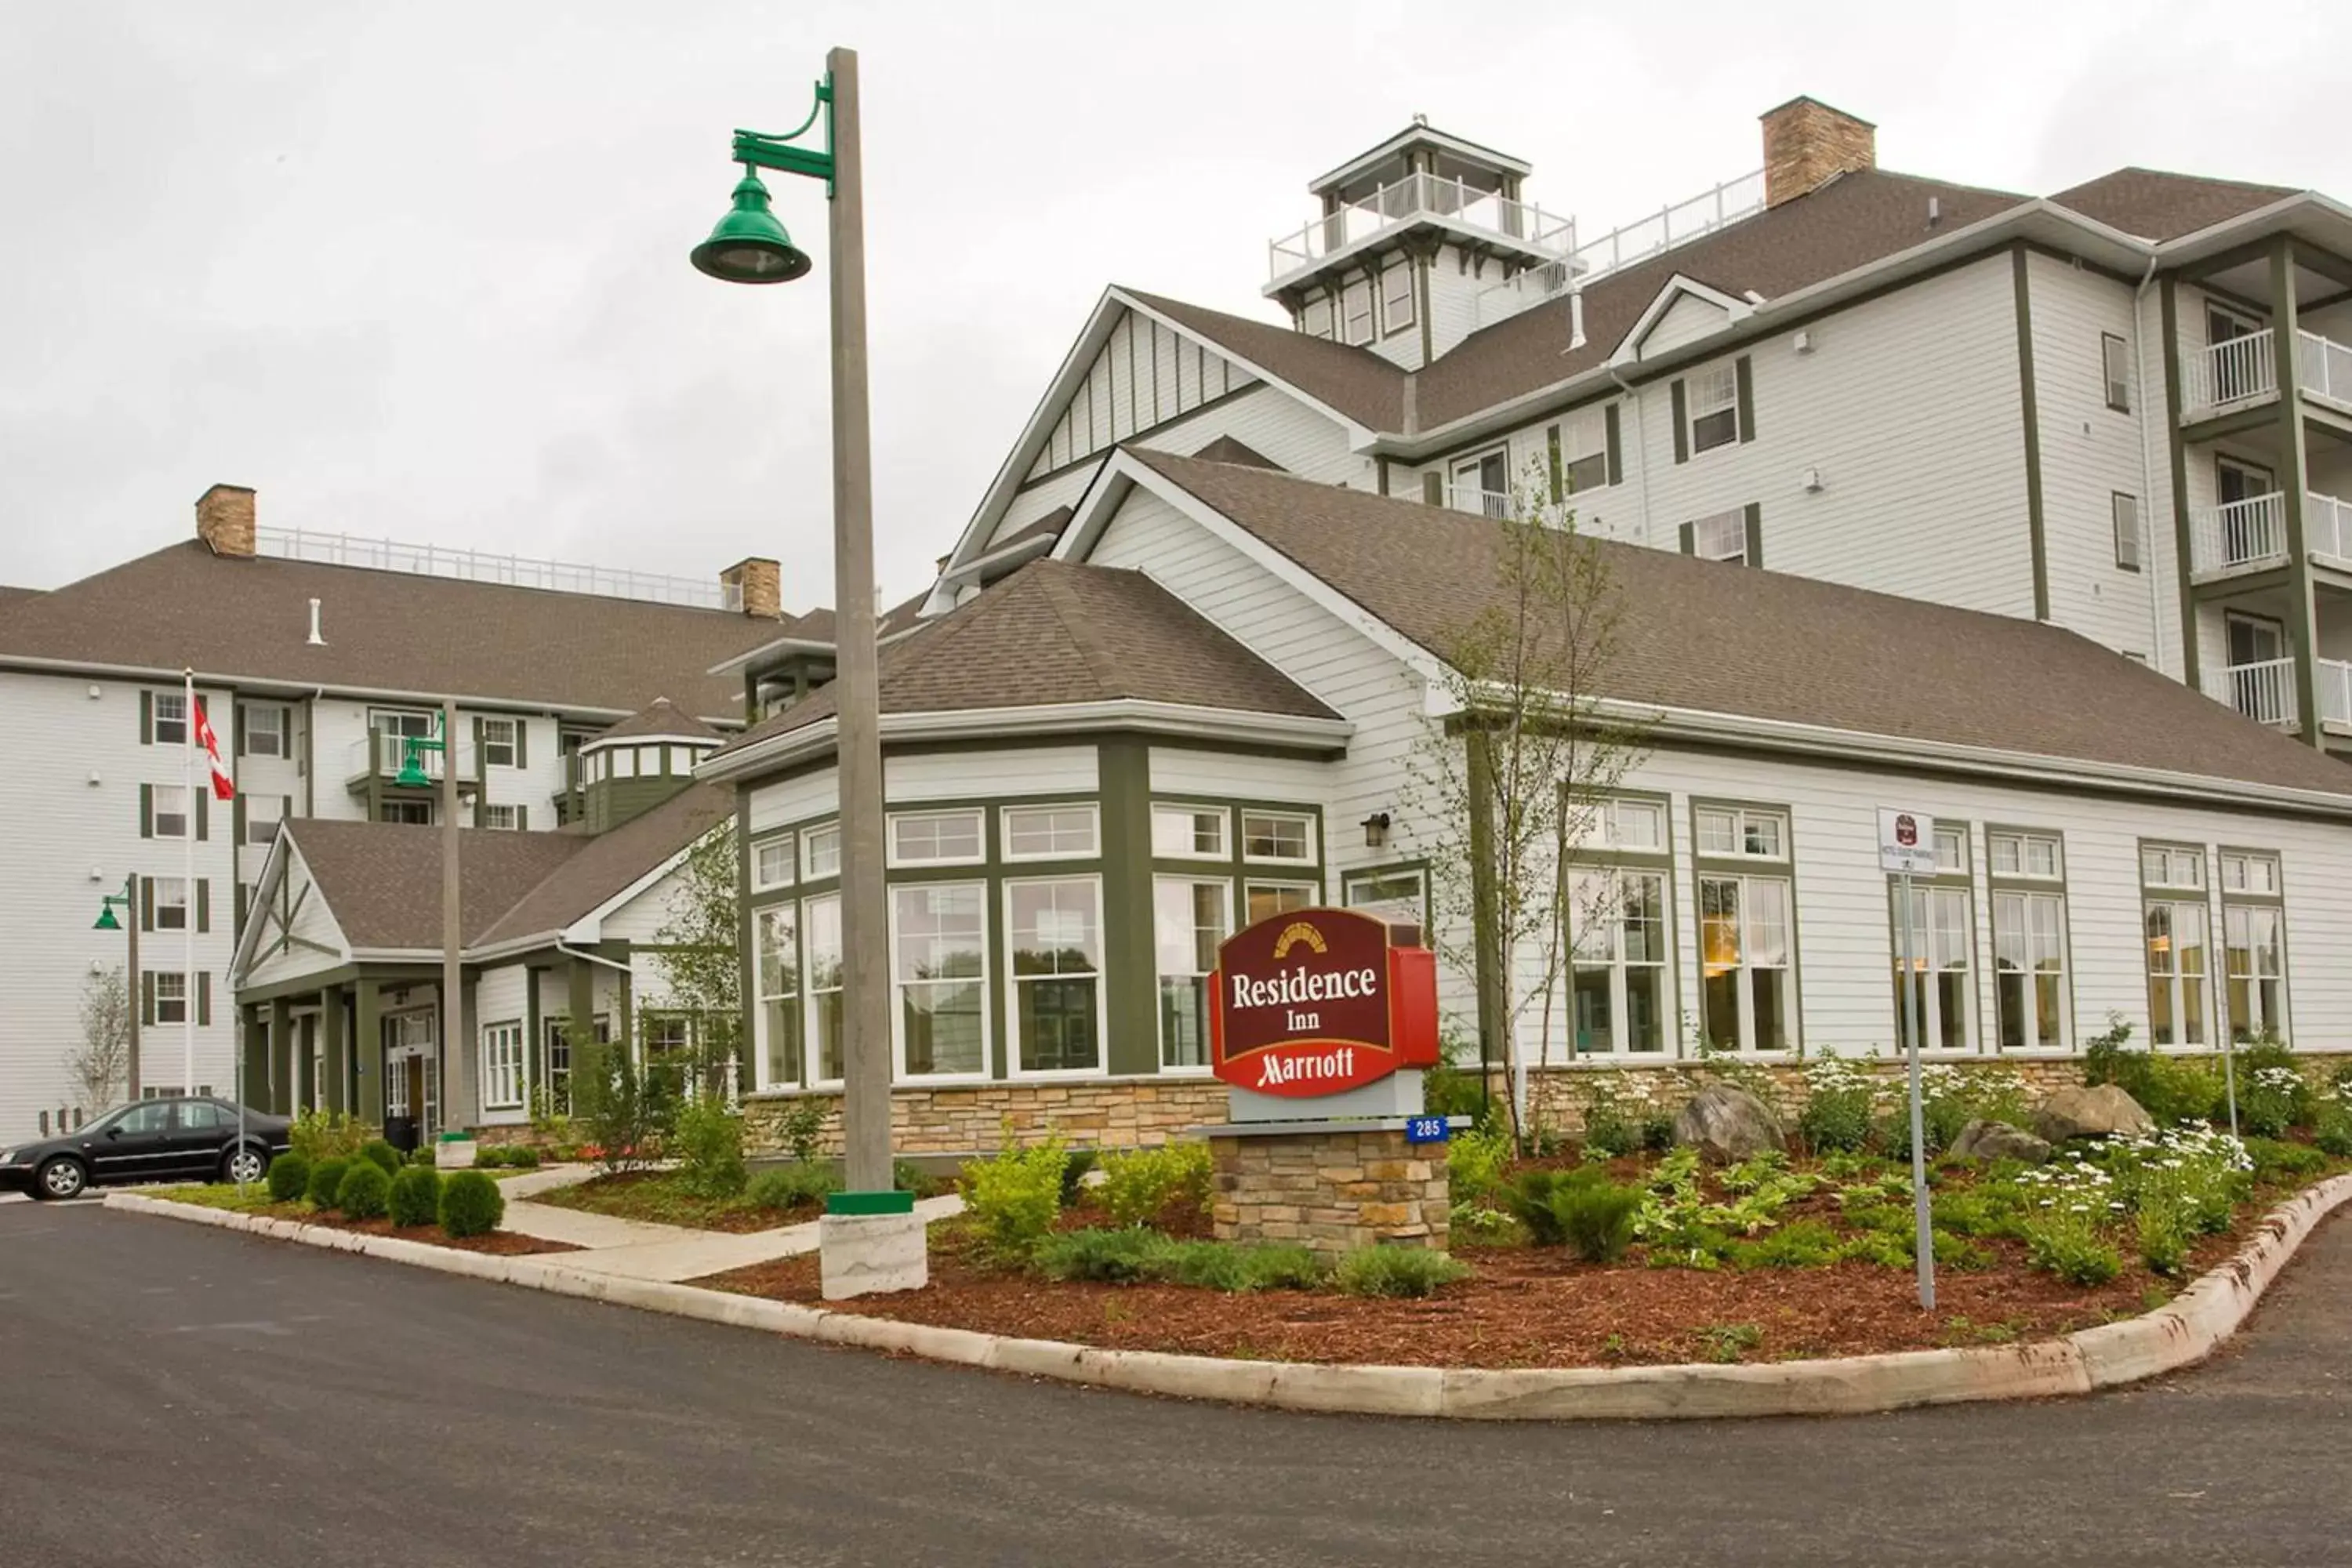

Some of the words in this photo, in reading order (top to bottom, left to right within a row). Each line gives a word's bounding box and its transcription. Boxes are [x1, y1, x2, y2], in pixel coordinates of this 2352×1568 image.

[1232, 967, 1376, 1008] Residence
[1287, 1010, 1320, 1031] Inn
[1257, 1048, 1353, 1087] Marriott
[1417, 1120, 1440, 1137] 285
